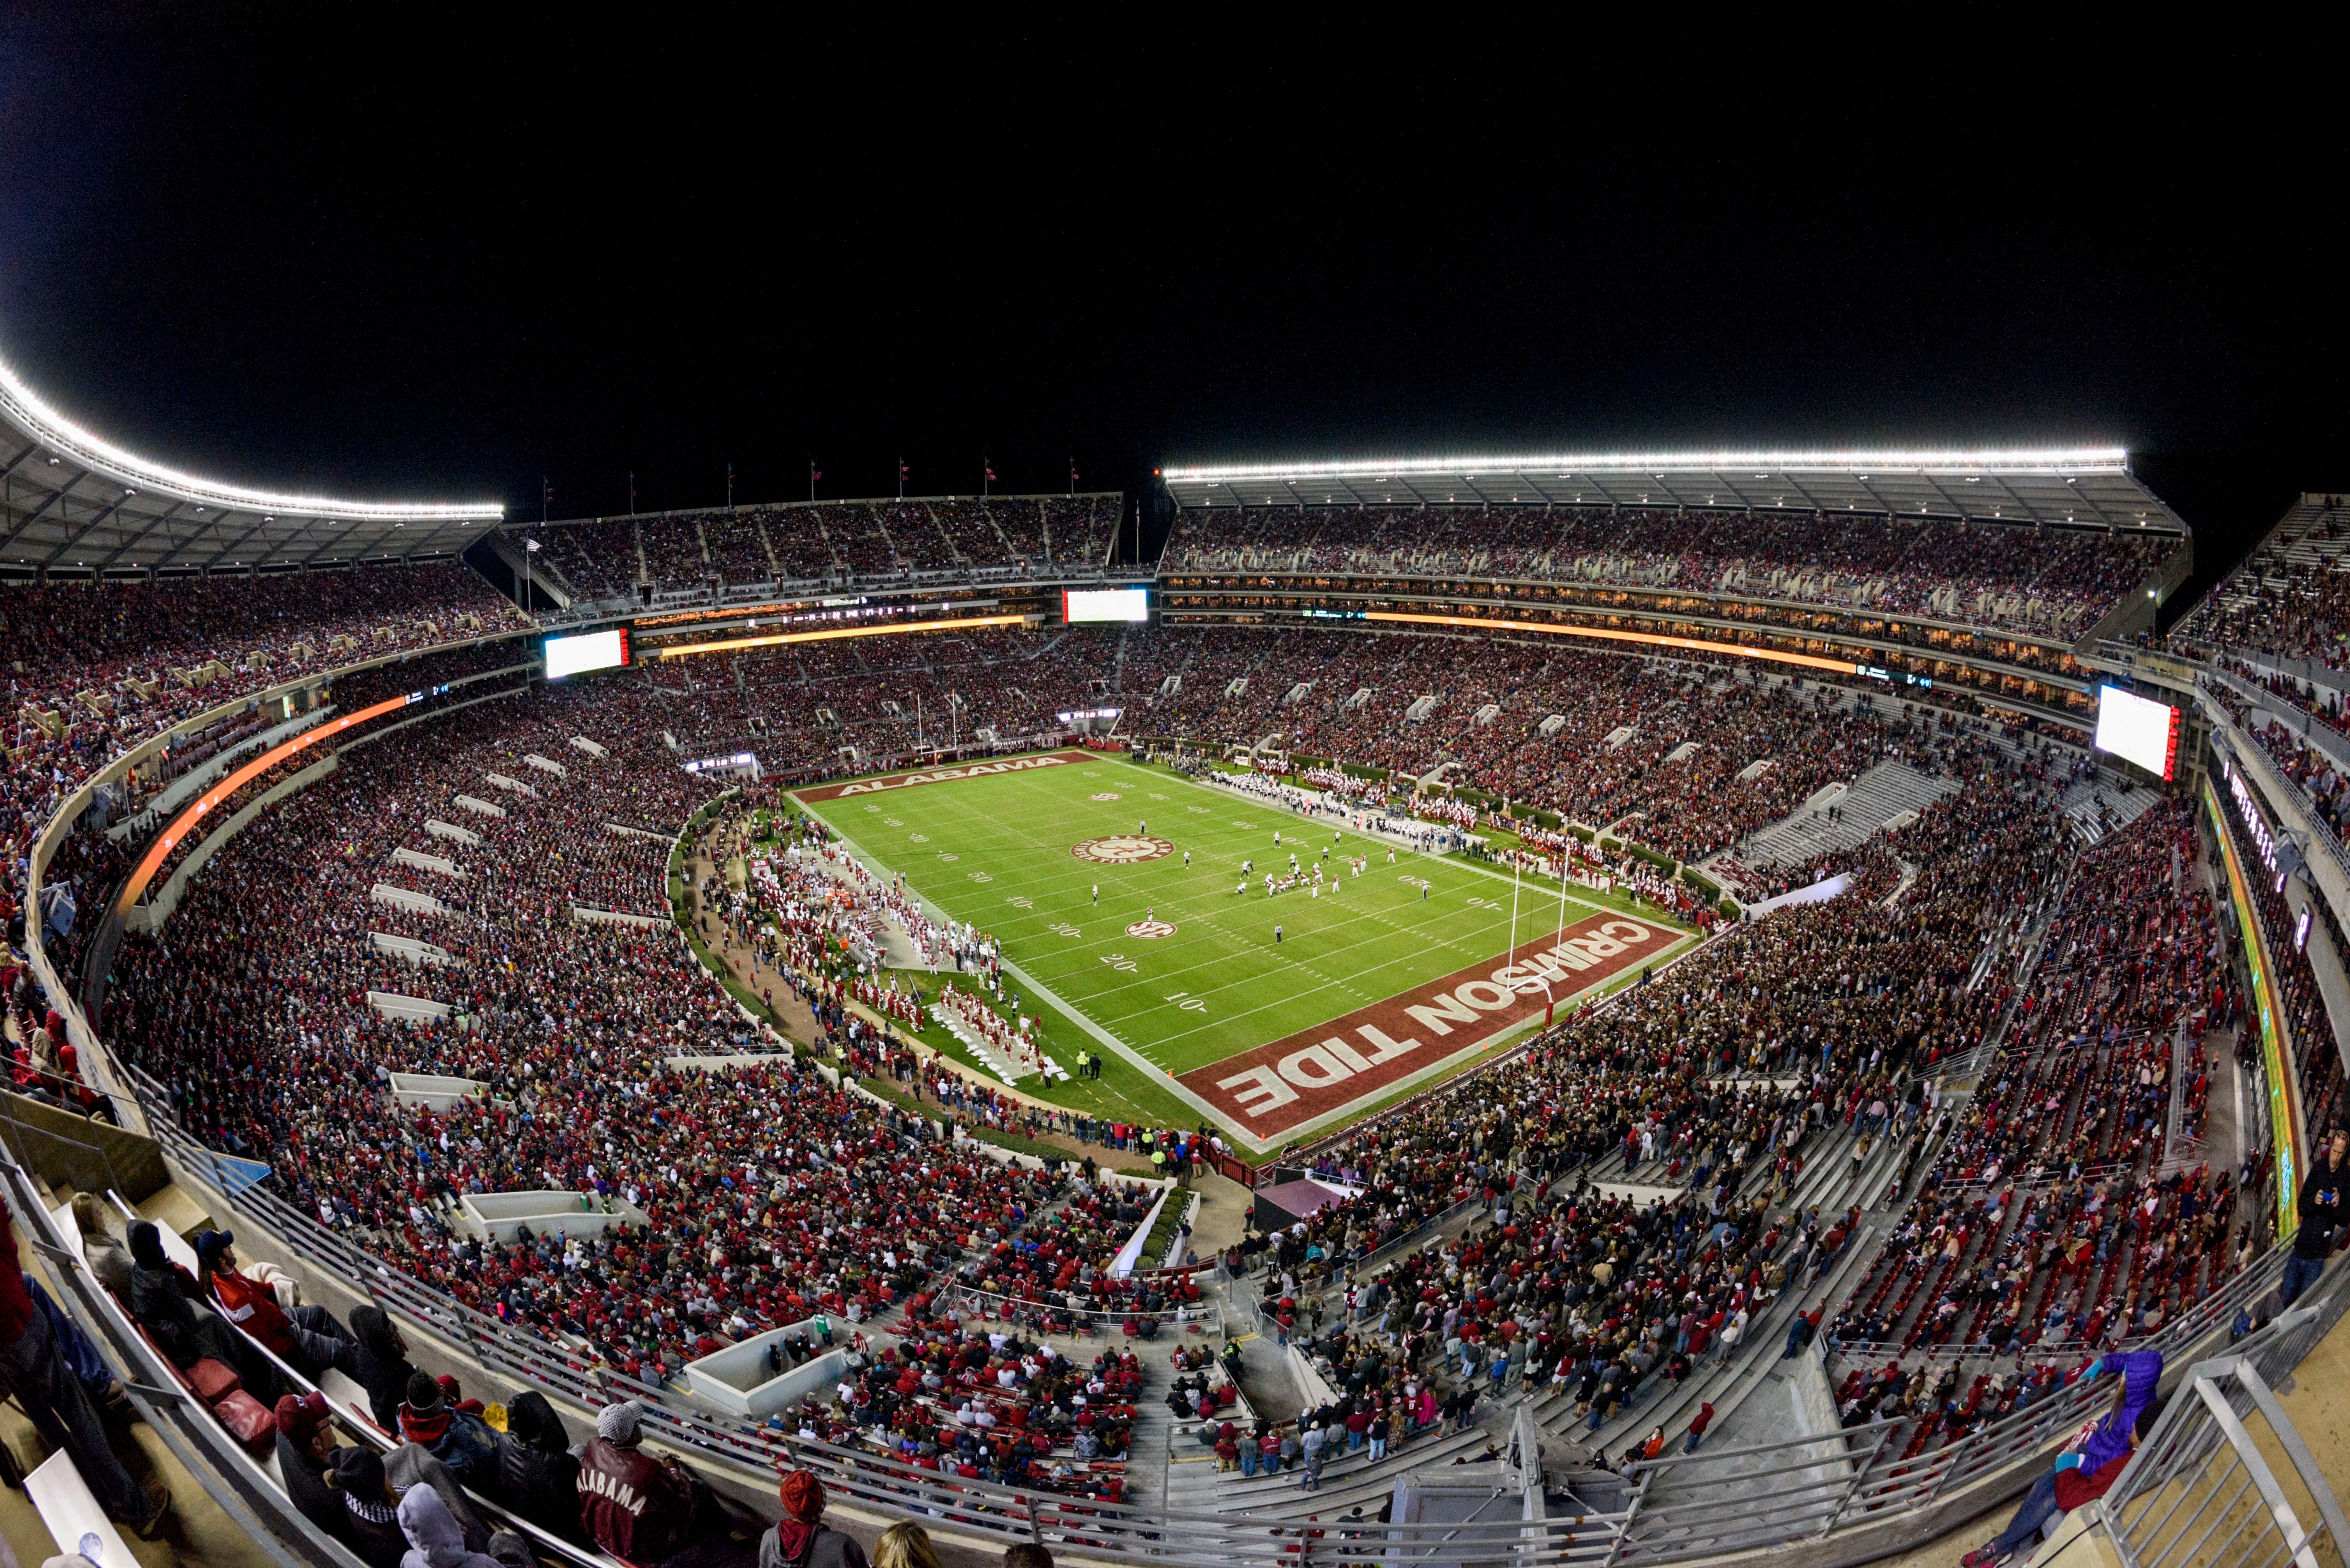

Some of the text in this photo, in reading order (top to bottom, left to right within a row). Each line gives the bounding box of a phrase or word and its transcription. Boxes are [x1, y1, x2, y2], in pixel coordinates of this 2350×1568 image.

[2164, 705, 2181, 781] ALABAMA
[838, 757, 1068, 797] ALABAMA
[967, 871, 992, 882] 50
[1049, 923, 1080, 936] 30
[1128, 921, 1172, 939] SEC
[1100, 953, 1137, 970] 20
[1163, 991, 1204, 1010] 10
[1216, 921, 1651, 1118] CRIMSON TIDE
[576, 1468, 647, 1516] ALABAMA
